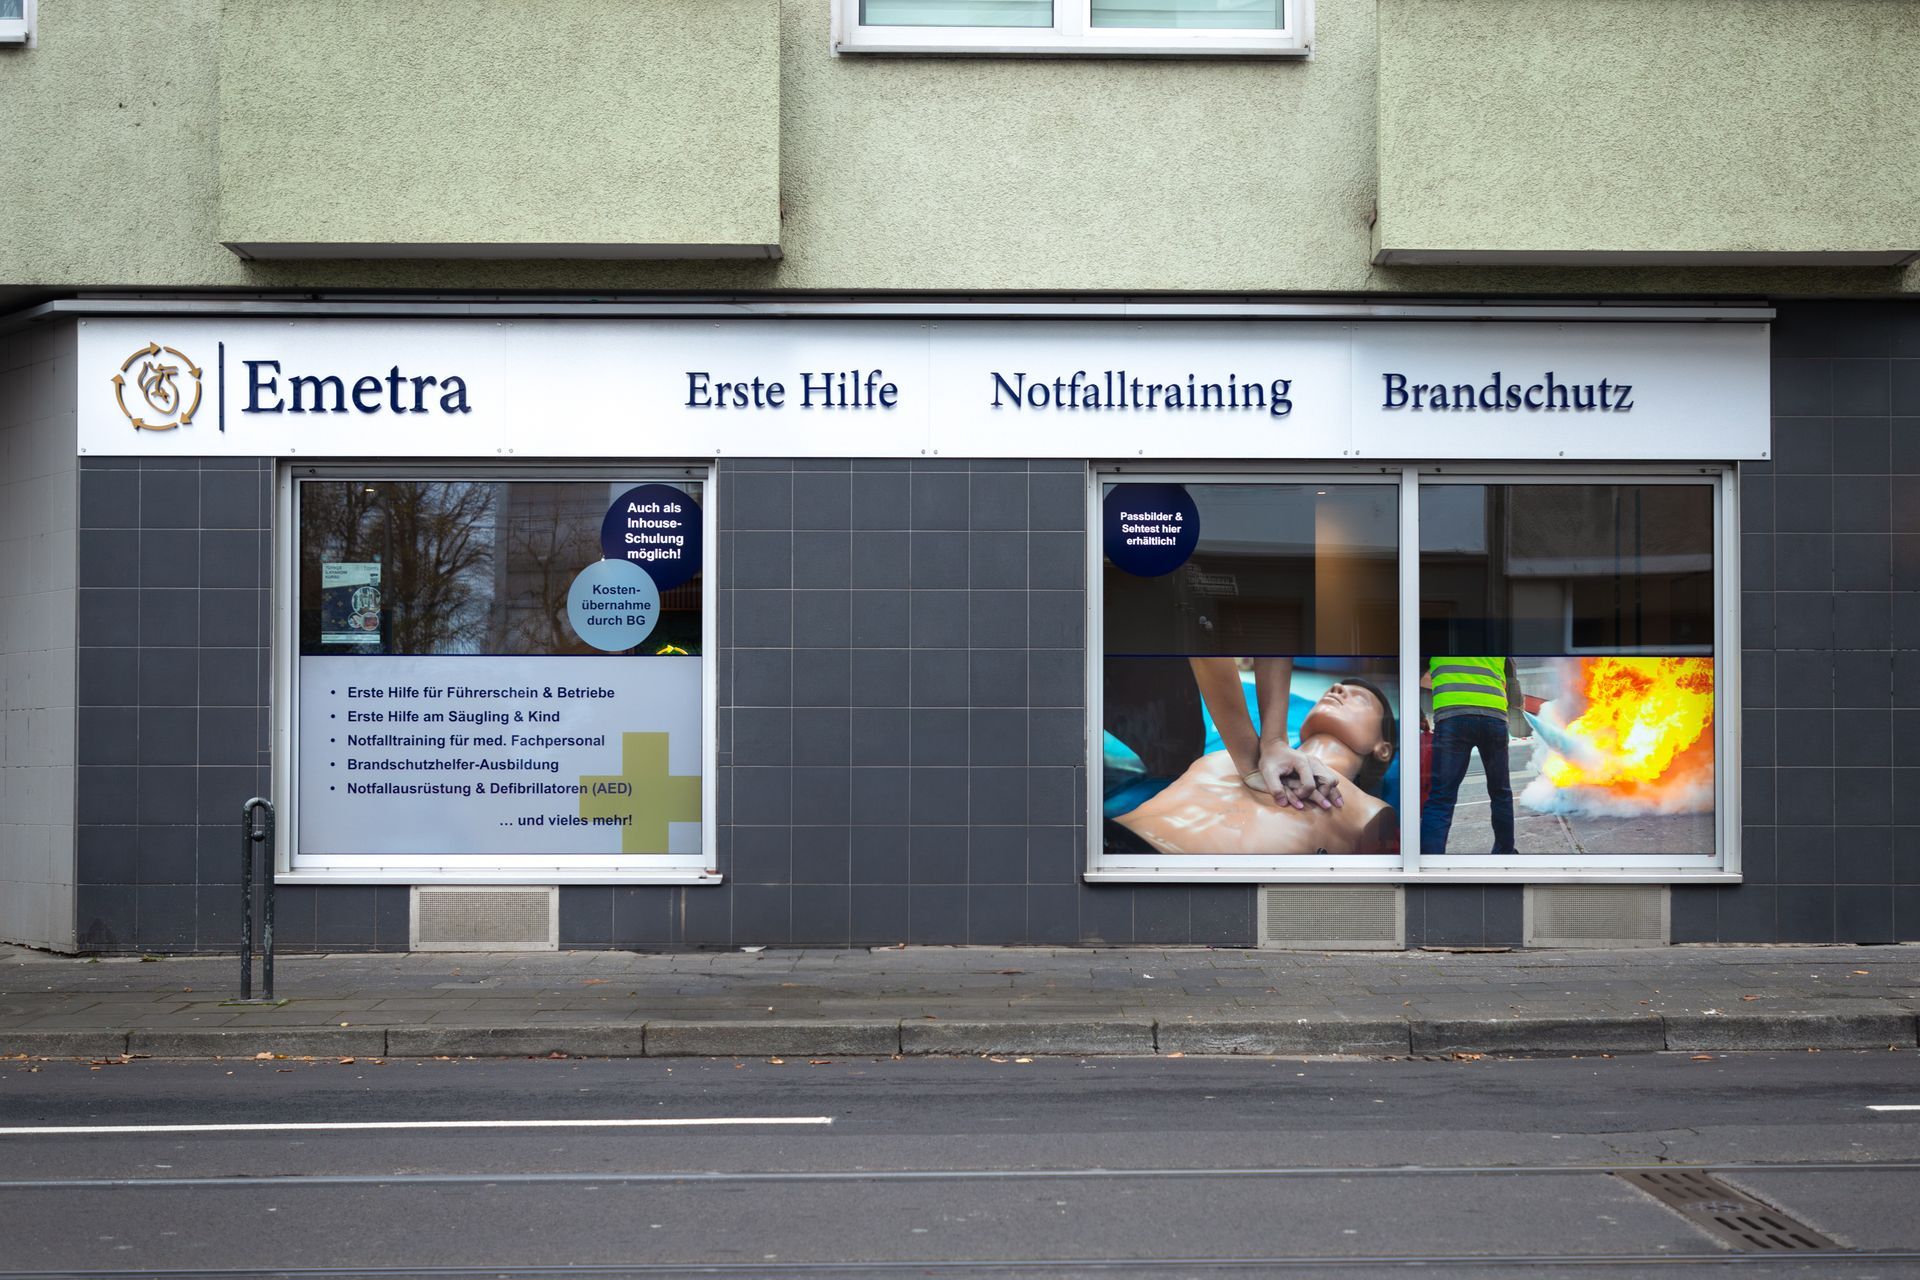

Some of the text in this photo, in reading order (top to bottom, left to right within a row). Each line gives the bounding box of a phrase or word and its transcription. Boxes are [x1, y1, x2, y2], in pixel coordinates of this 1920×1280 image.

[241, 360, 472, 414] Emetra
[685, 369, 898, 408] Erste Hilfe
[990, 370, 1293, 416] Notfalltraining
[1382, 371, 1634, 410] Brandschutz
[627, 502, 682, 513] Auch als
[1120, 511, 1183, 521] Passbilder &
[627, 518, 682, 528] Inhouse-
[1121, 524, 1182, 533] Sehtest hier
[625, 533, 684, 546] Schulung
[1126, 536, 1176, 546] erhältlich!
[627, 548, 681, 562] möglich!
[592, 584, 641, 595] Kosten-
[582, 600, 651, 610] übernahme
[587, 615, 646, 626] durch BG
[348, 687, 615, 698] Erste Hilfe für Führerschein & Betriebe
[348, 711, 560, 725] Erste Hilfe am Säugling & Kind
[347, 735, 605, 749] Notfalltraining für med. Fachpersonal
[347, 758, 559, 773] Brandschutzhelfer-Ausbildung
[347, 783, 632, 797] Notfallausrüstung & Defibrillatoren (AED)
[518, 815, 544, 826] und
[548, 815, 589, 826] vieles
[592, 815, 633, 826] mehr!
